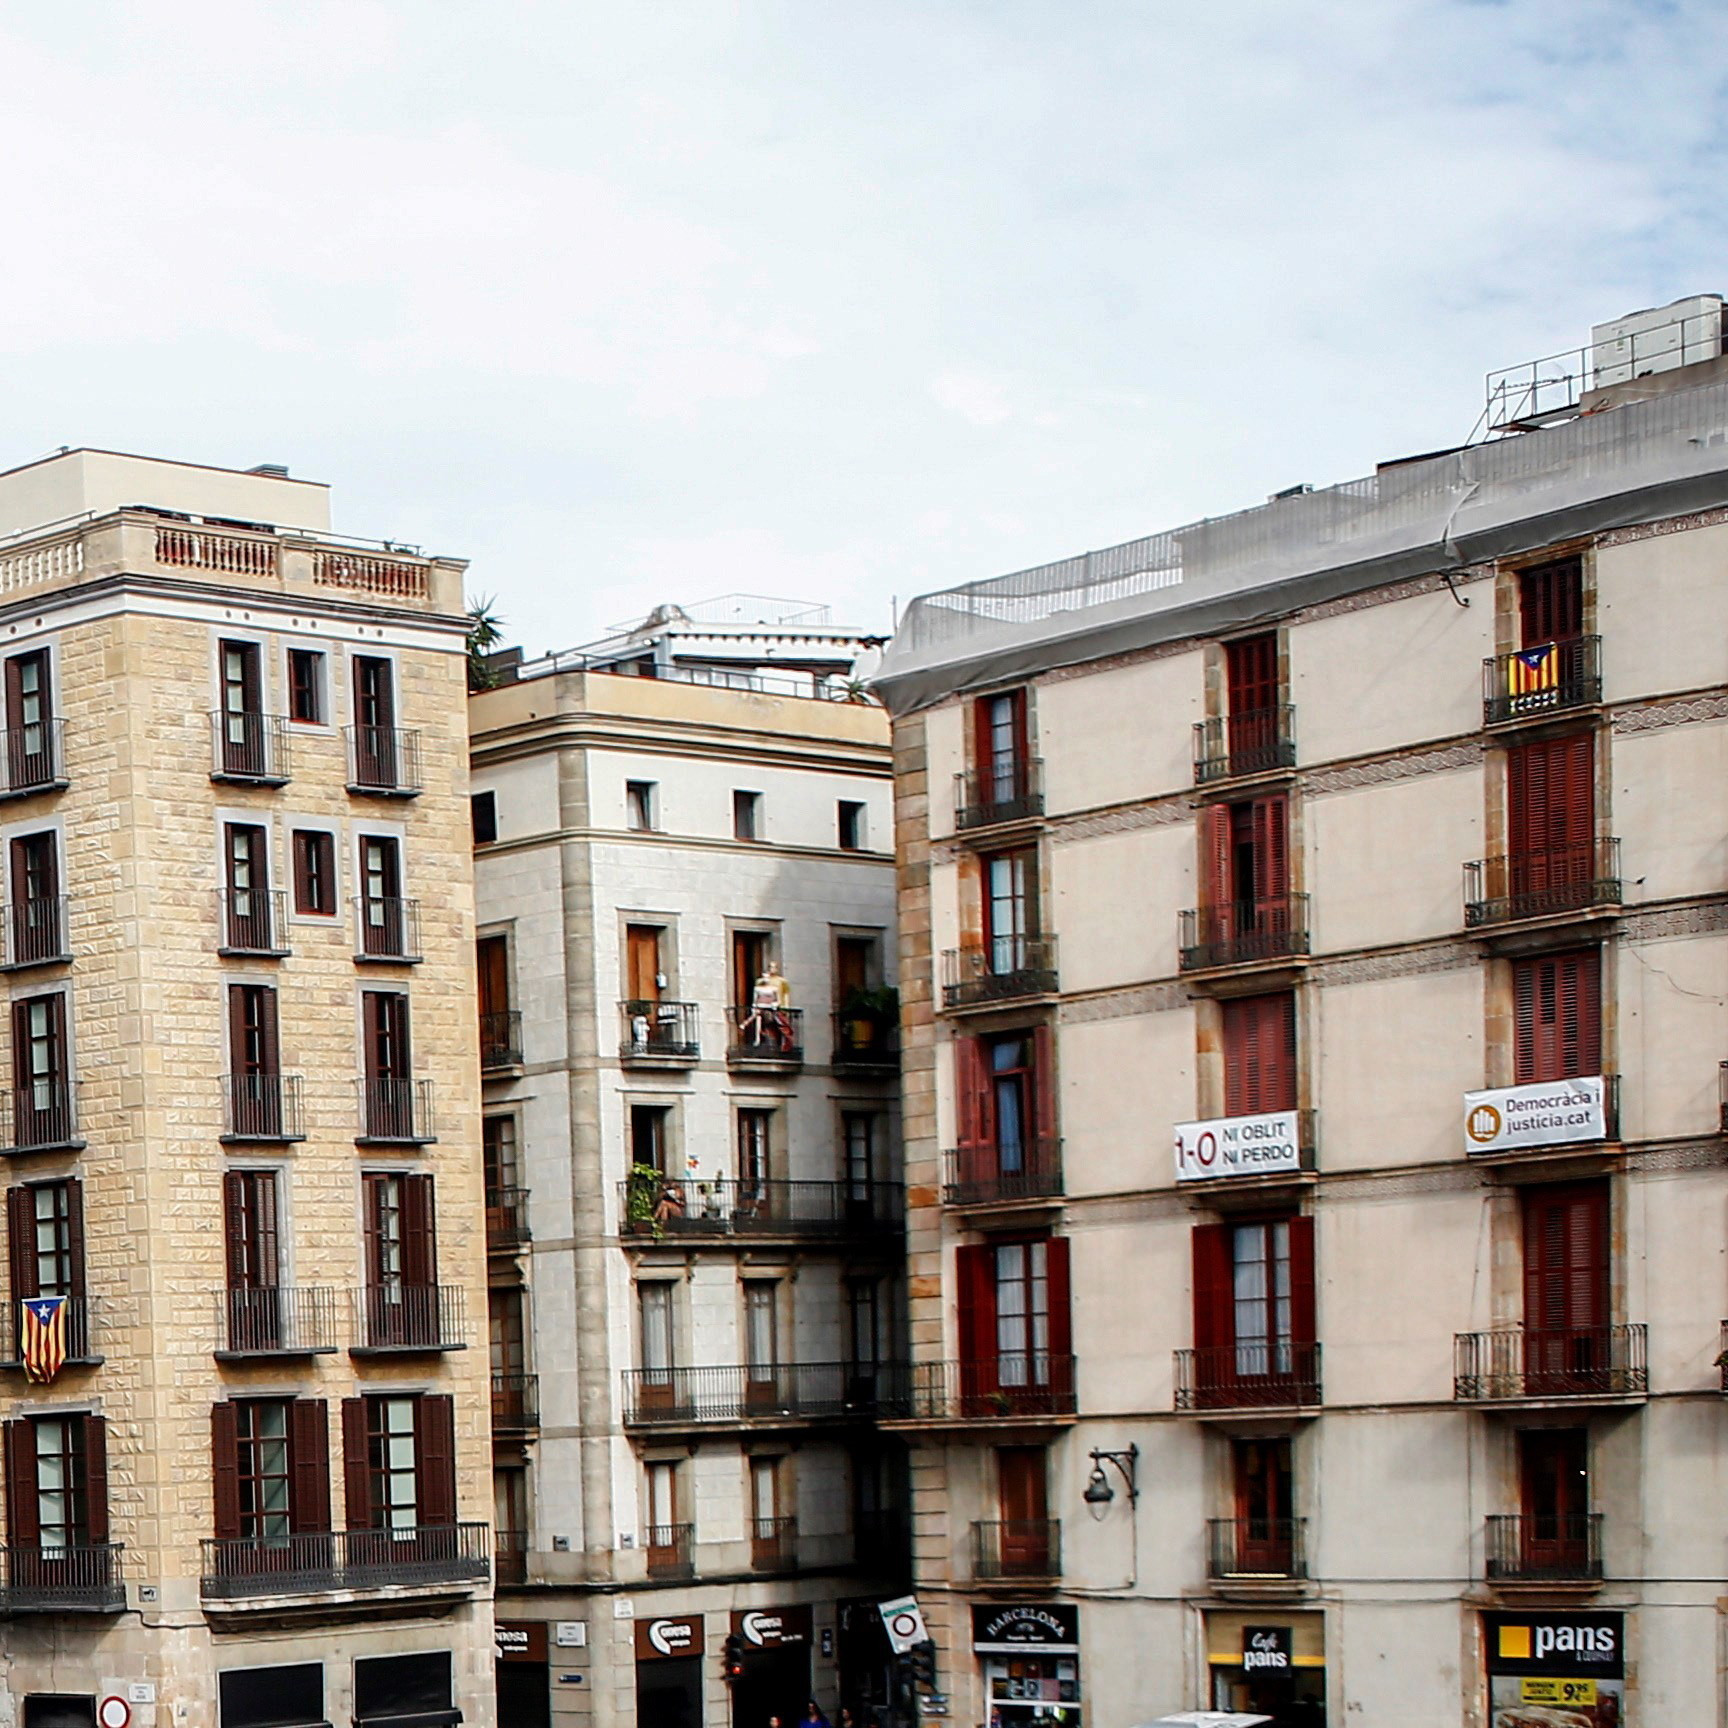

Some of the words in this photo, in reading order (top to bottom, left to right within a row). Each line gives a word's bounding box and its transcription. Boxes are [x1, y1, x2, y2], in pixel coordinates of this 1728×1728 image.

[1506, 1091, 1591, 1112] Democràcia
[1595, 1088, 1600, 1102] i
[1222, 1128, 1238, 1142] NI
[1242, 1122, 1286, 1140] OBLIT
[1223, 1151, 1238, 1164] NI
[1535, 1625, 1615, 1658] pans
[1244, 1651, 1288, 1672] pans
